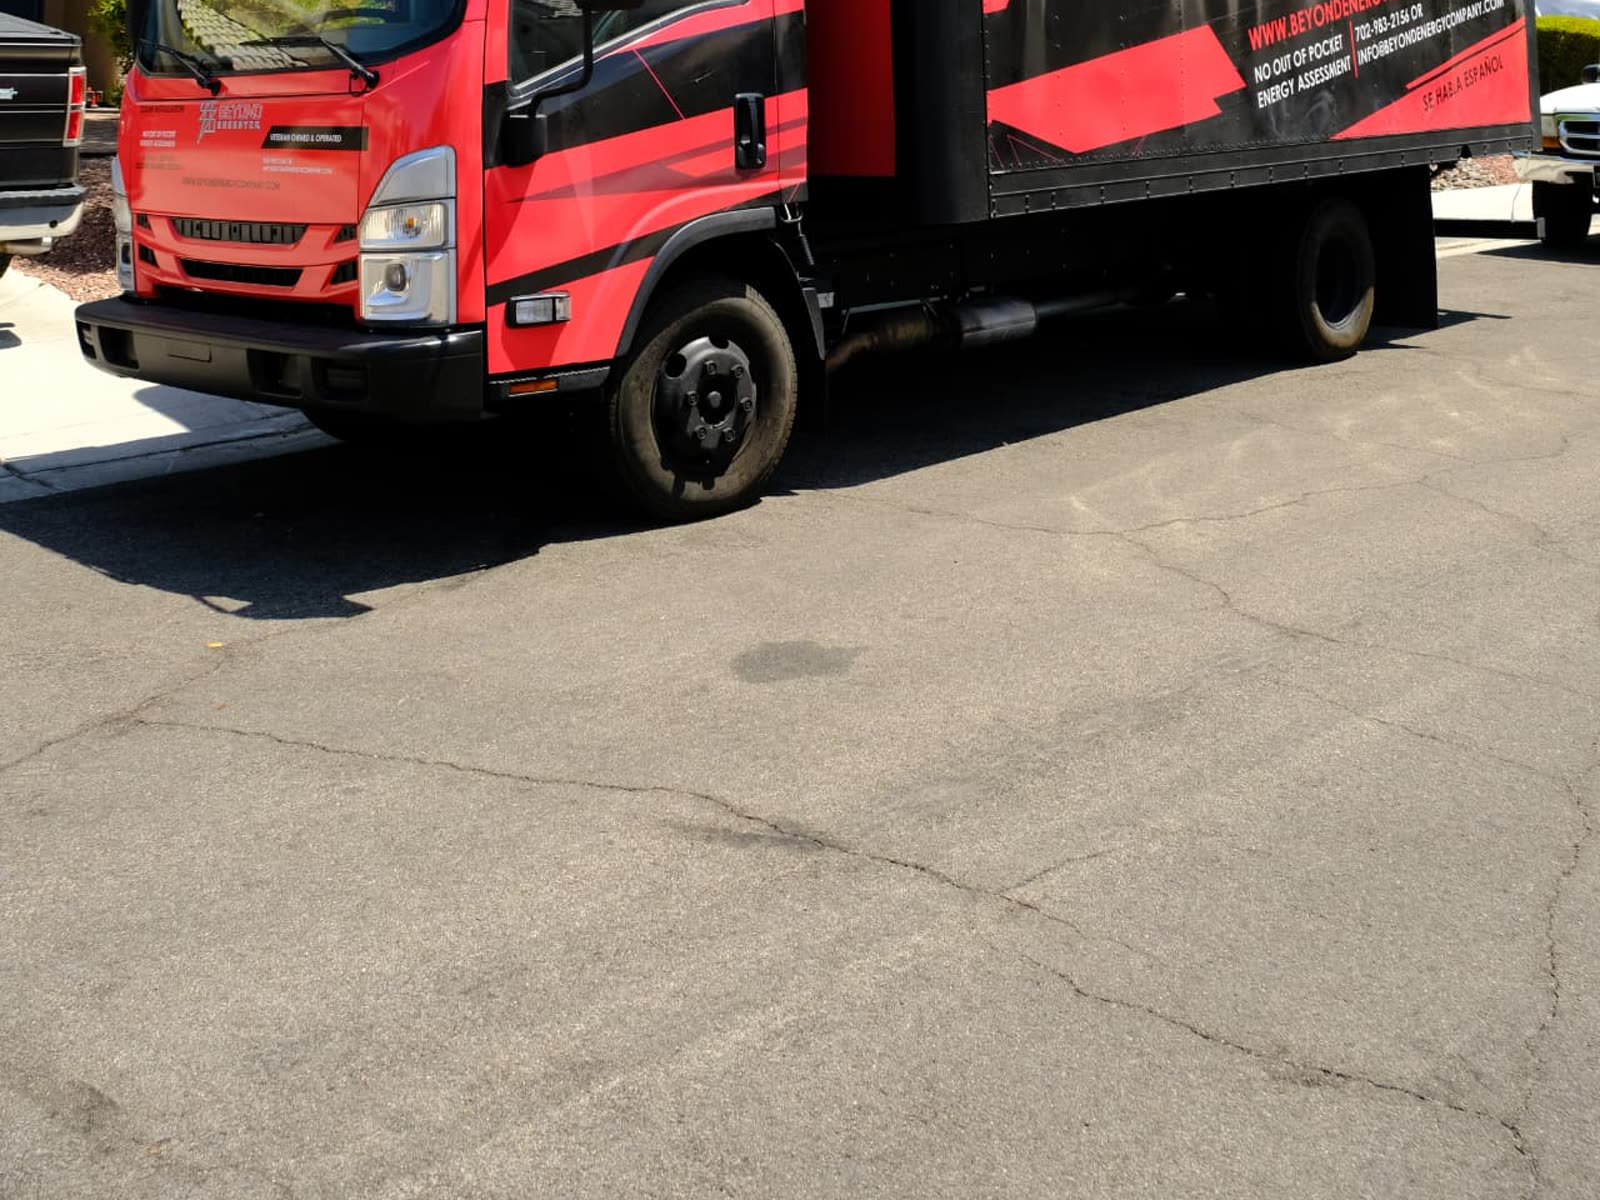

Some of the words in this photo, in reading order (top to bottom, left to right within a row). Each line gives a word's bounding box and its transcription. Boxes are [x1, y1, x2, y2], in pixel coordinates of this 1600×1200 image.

[1354, 10, 1410, 43] 702-983-2156
[1410, 2, 1424, 20] OR
[1253, 62, 1271, 84] NO
[1272, 53, 1292, 77] OUT
[1292, 49, 1308, 69] OF
[1309, 33, 1344, 62] POCKET
[1256, 79, 1297, 110] ENERGY
[1297, 55, 1352, 93] ASSESSMENT
[1421, 91, 1434, 112] SE
[1463, 55, 1504, 88] ESPAÑOL
